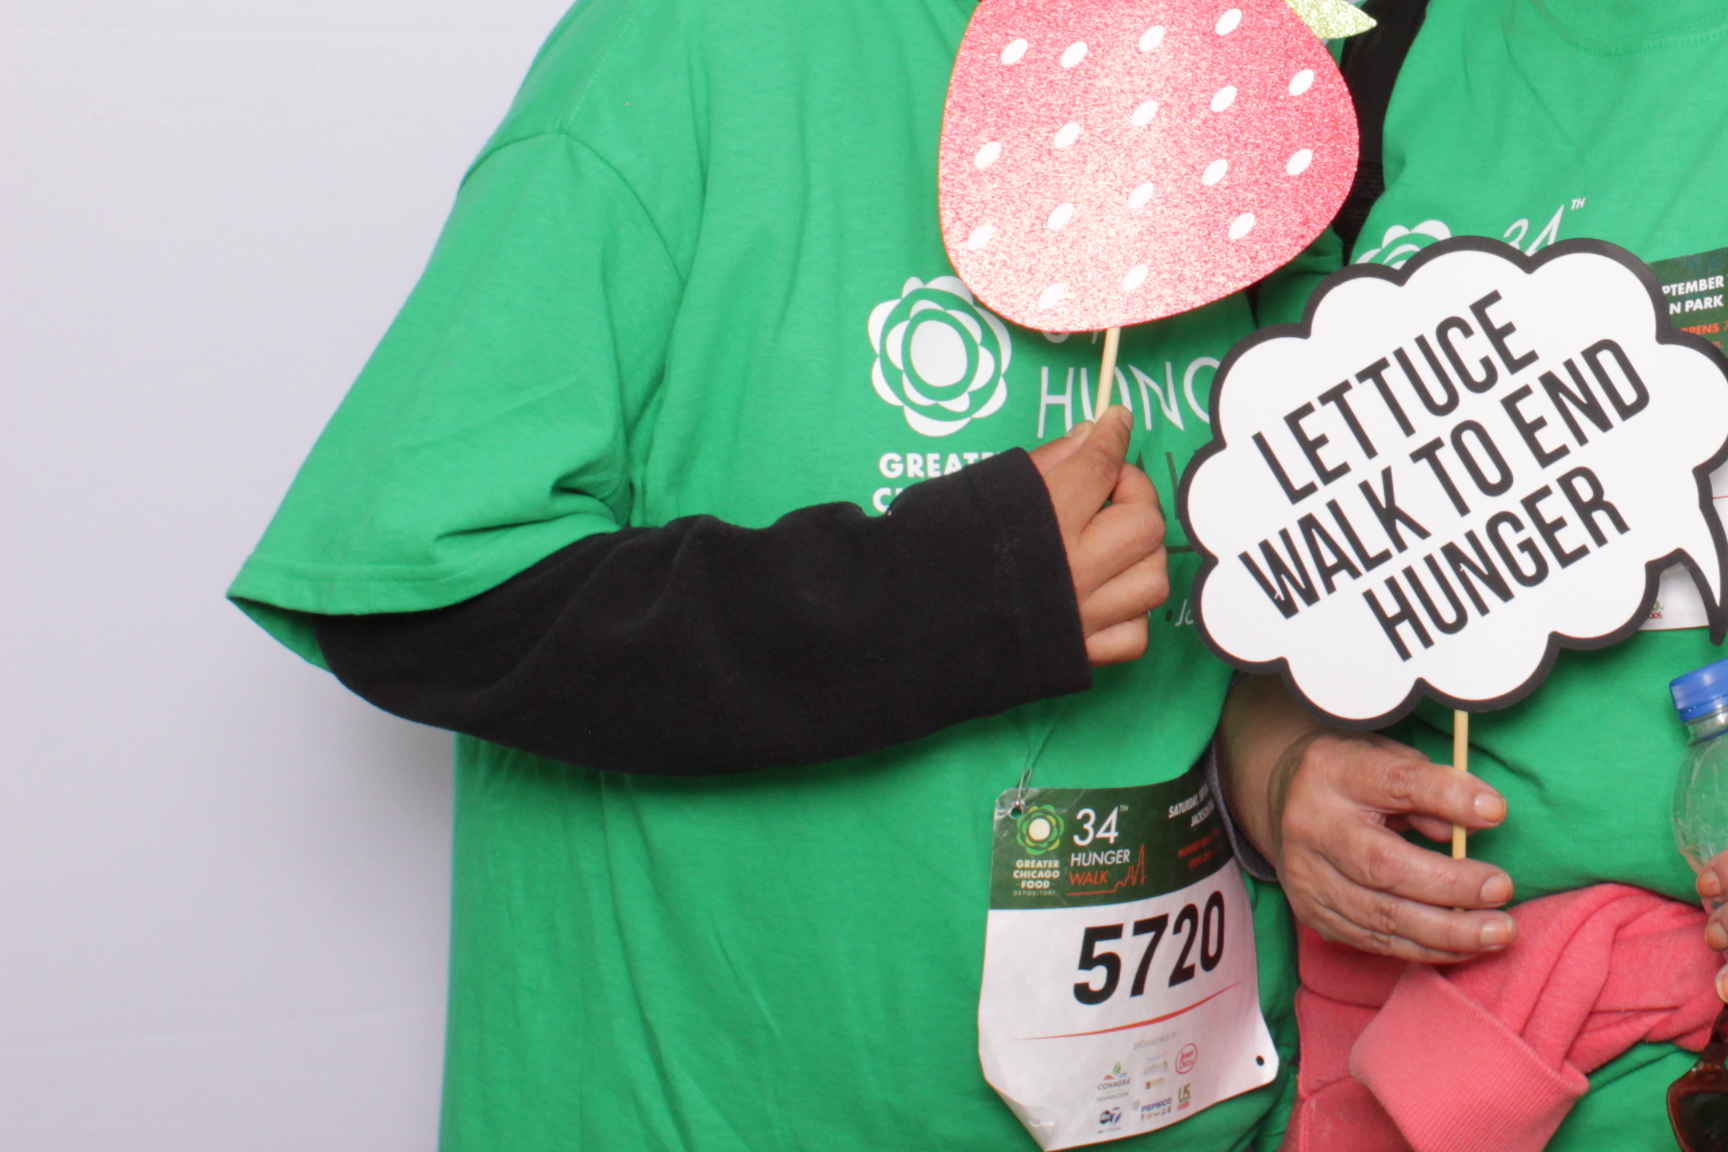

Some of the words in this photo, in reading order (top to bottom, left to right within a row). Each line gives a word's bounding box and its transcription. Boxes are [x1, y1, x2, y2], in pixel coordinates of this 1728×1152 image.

[1662, 275, 1724, 297] PTEMBER
[1684, 295, 1724, 316] PARK
[1037, 356, 1221, 438] HUN
[1251, 289, 1540, 506] LETTUCE
[879, 451, 1000, 479] GREAT
[1238, 465, 1432, 620] WALK
[1409, 419, 1514, 518] TO
[1500, 338, 1650, 469] END
[1362, 465, 1631, 662] HUNGER
[1015, 859, 1060, 870] GREATER
[1070, 848, 1131, 867] HUNGER
[1013, 869, 1060, 880] CHICAGO
[1020, 880, 1051, 890] FOOD
[1068, 870, 1109, 886] WALK
[1073, 890, 1225, 1006] 5720
[1097, 1078, 1131, 1091] CONAGRA
[1141, 1097, 1172, 1113] PEPSICO
